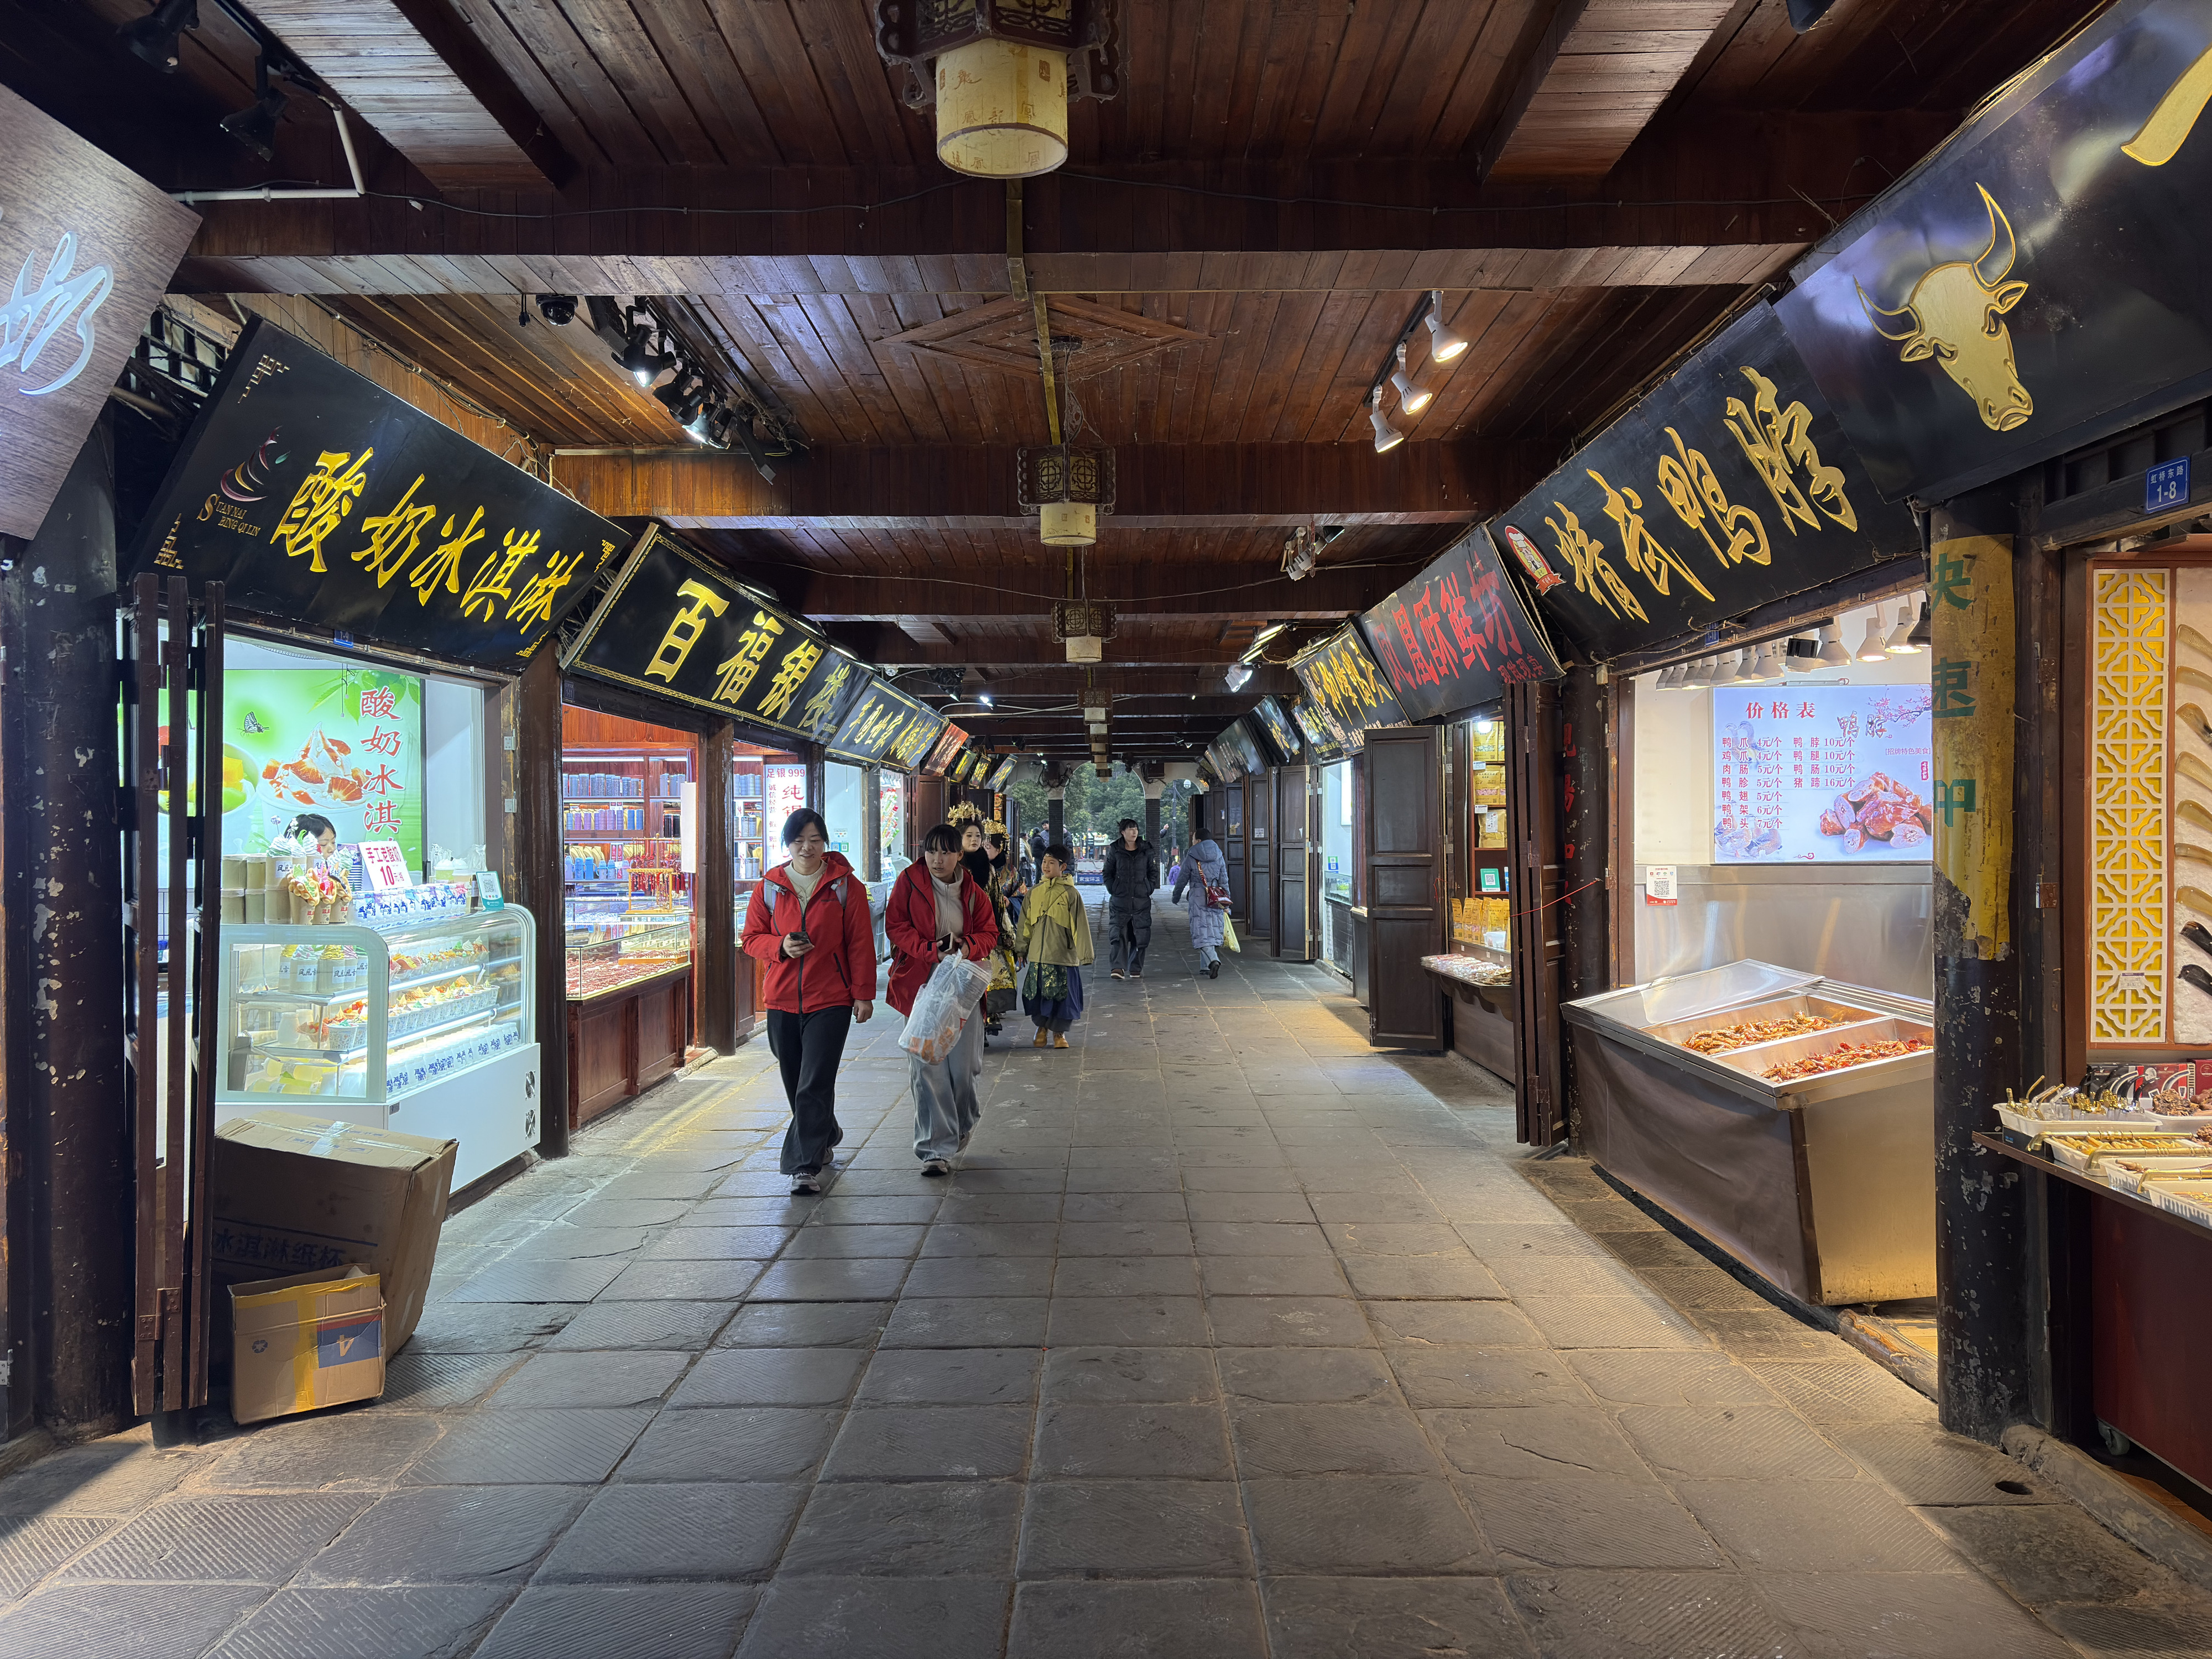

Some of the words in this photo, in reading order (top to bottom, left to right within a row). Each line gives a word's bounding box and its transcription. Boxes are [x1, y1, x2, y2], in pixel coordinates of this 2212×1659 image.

[2150, 465, 2184, 484] 虹桥东路
[2157, 481, 2177, 503] 1-8
[270, 447, 584, 635] 酸奶冰淇淋
[340, 630, 349, 642] 1-9
[644, 578, 851, 731] 百福银楼
[1745, 701, 1816, 719] 价格表
[1837, 710, 1887, 738] 鸭脖
[1722, 737, 1749, 748] 鸭爪
[1756, 737, 1783, 748] 4元/个
[1793, 737, 1820, 748] 鸭脖
[1824, 737, 1855, 748] 10元/个
[1722, 750, 1749, 761] 鸡爪
[1756, 750, 1783, 761] 4元/个
[1793, 750, 1820, 761] 鸭腿
[1824, 749, 1855, 761] 10元/个
[360, 686, 405, 841] 酸奶冰淇
[1723, 764, 1749, 775] 肉肠
[1757, 764, 1783, 775] 5元/个
[1793, 764, 1820, 775] 鸭肠
[1824, 763, 1856, 774] 10元/个
[766, 768, 785, 779] 足银
[788, 769, 805, 777] 999
[1757, 777, 1783, 789] 5元/个
[1793, 777, 1821, 789] 猪蹄
[1824, 777, 1856, 788] 16元/个
[1721, 790, 1749, 801] 鸭翅
[1757, 791, 1783, 802] 5元/个
[1722, 804, 1749, 815] 鸭架
[1757, 804, 1783, 816] 6元/个
[1723, 817, 1749, 829] 鸭头
[1757, 817, 1783, 829] 7元/个
[365, 846, 403, 864] 手工老酸奶
